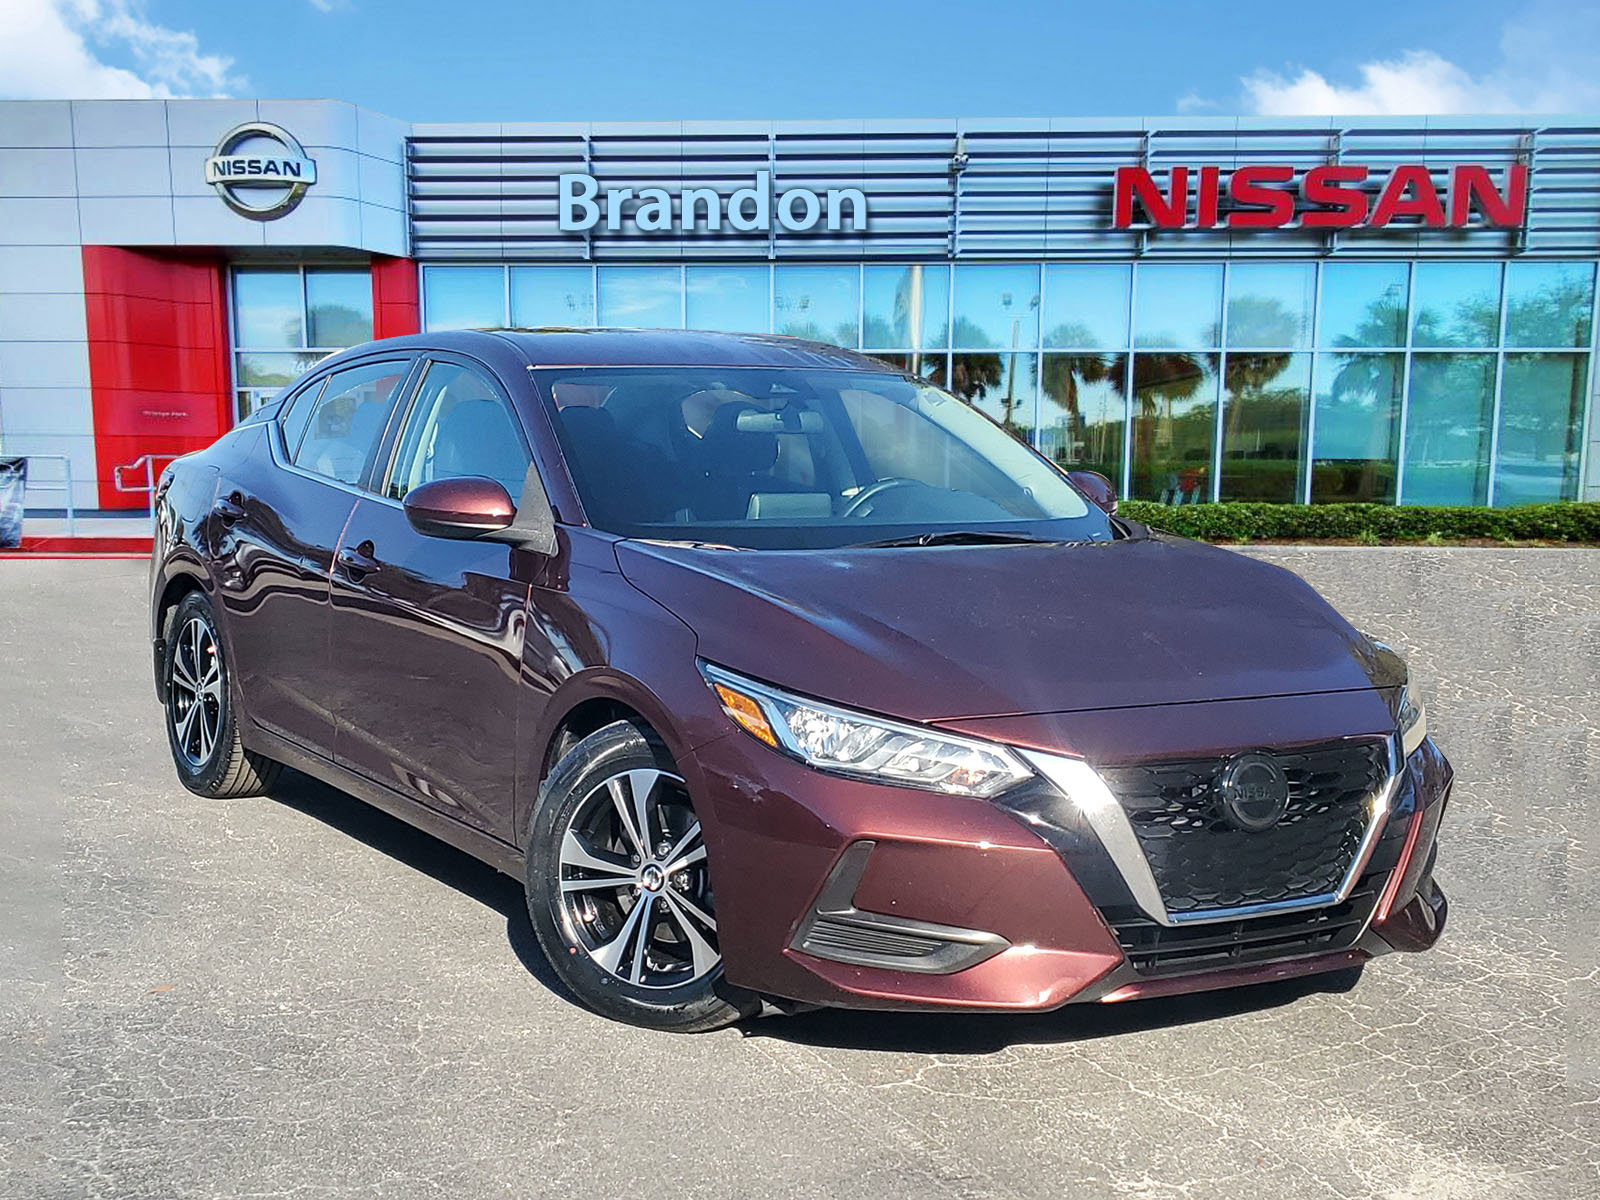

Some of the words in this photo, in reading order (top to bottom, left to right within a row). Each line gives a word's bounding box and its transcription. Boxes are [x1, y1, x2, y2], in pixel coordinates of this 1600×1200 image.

[213, 159, 301, 177] NISSAN
[1114, 164, 1528, 229] NISSAN
[559, 170, 867, 231] Brandon
